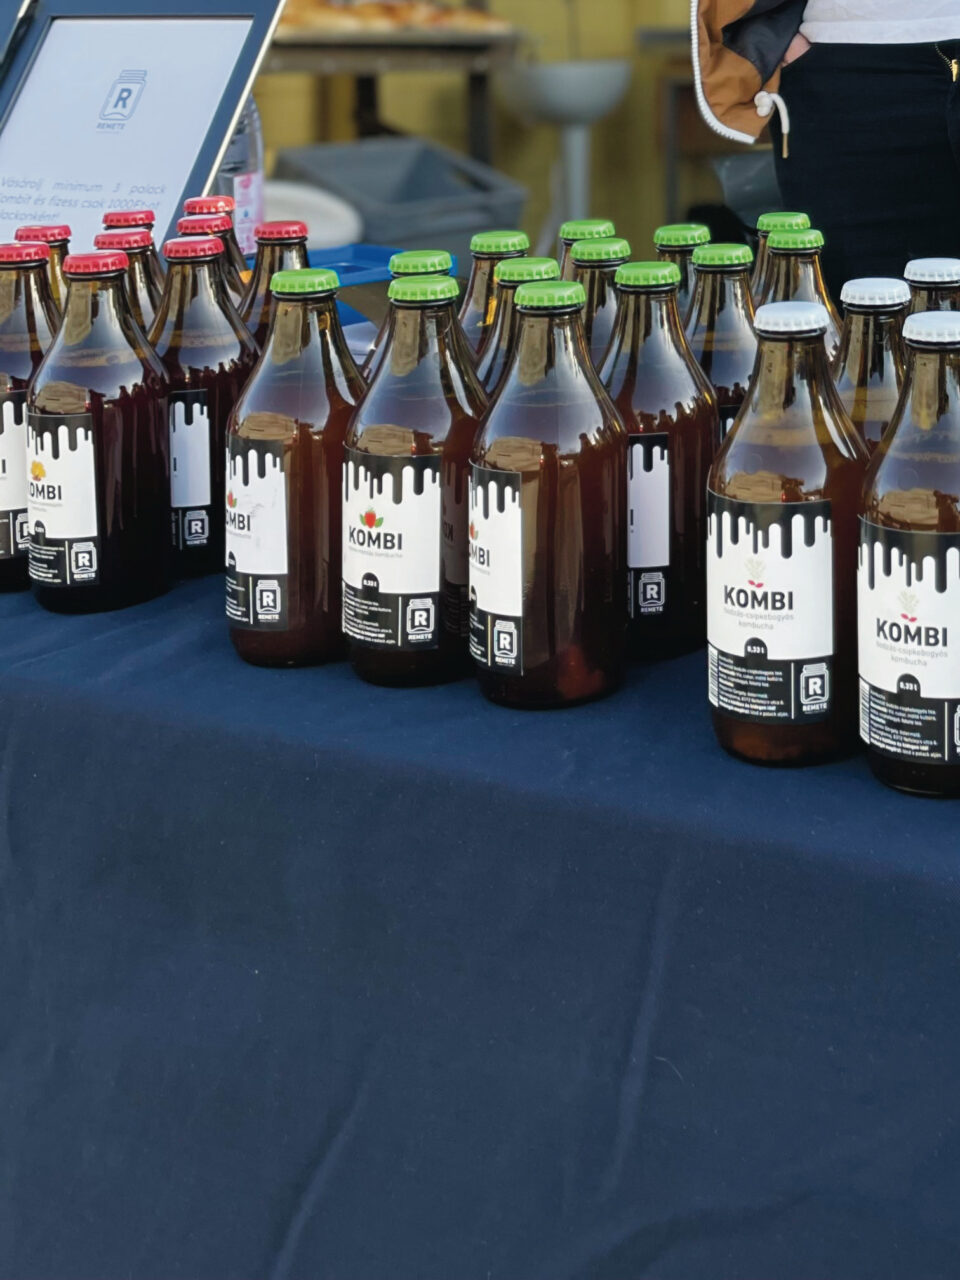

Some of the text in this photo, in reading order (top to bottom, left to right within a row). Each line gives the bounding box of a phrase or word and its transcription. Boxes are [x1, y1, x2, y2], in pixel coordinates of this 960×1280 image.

[113, 87, 132, 109] R
[29, 482, 62, 500] OMBI
[191, 520, 203, 534] R
[349, 525, 403, 550] KOMBI
[77, 552, 91, 567] R
[262, 591, 275, 607] R
[646, 584, 659, 600] R
[723, 585, 794, 611] KOMBI
[414, 610, 428, 626] R
[499, 632, 511, 650] R
[876, 617, 948, 647] KOMBI
[808, 677, 822, 696] R
